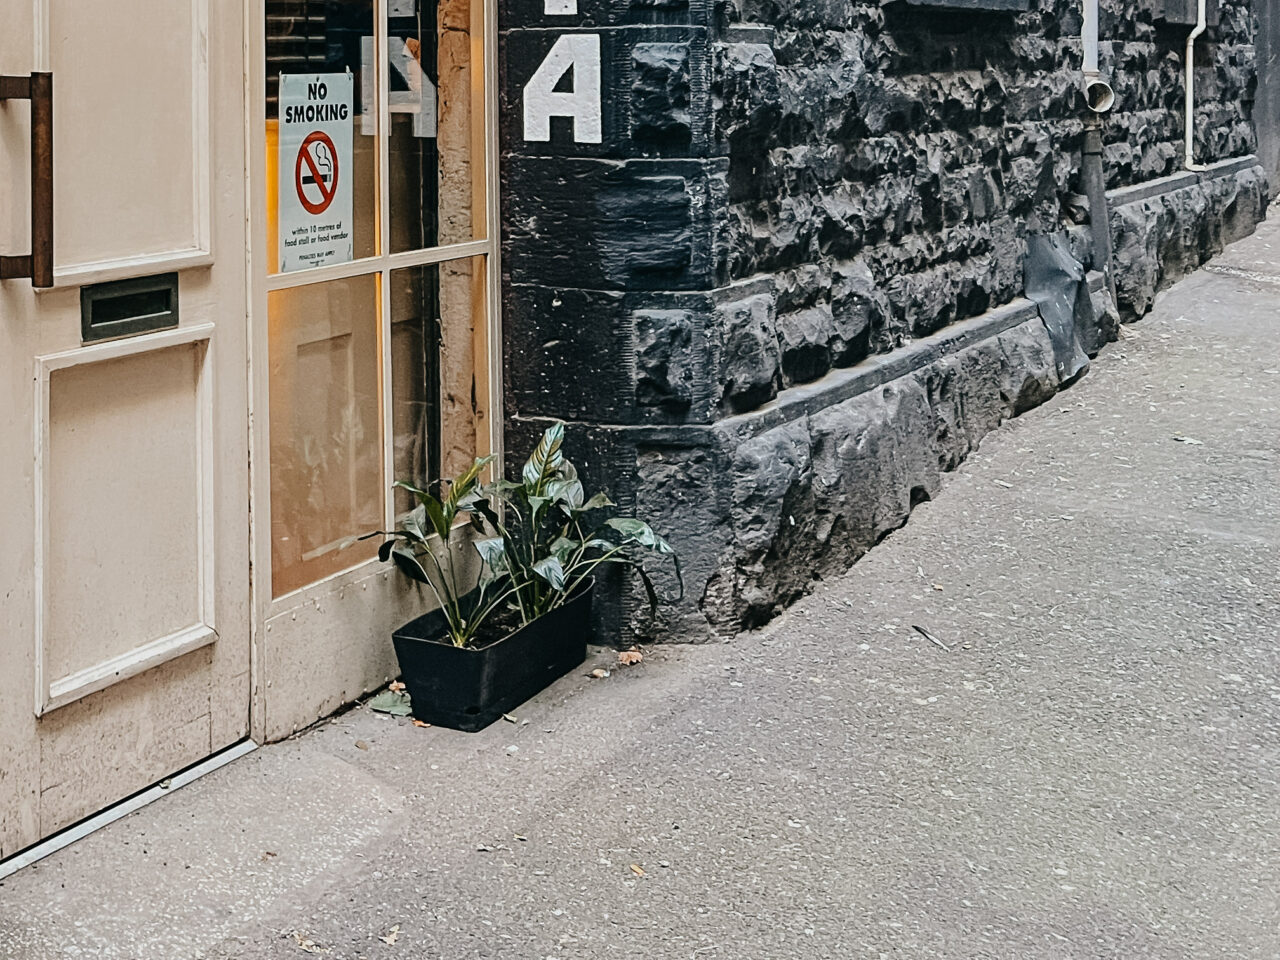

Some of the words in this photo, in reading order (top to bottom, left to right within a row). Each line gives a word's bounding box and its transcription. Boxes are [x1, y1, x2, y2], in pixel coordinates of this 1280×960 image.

[308, 82, 328, 100] NO
[285, 103, 349, 123] SMOKING
[291, 226, 309, 236] within
[310, 225, 317, 234] 10
[317, 224, 335, 232] metres
[336, 220, 342, 230] of
[284, 238, 297, 248] food
[298, 235, 310, 245] stall
[310, 236, 317, 244] or
[317, 233, 330, 243] food
[330, 230, 349, 241] vendor
